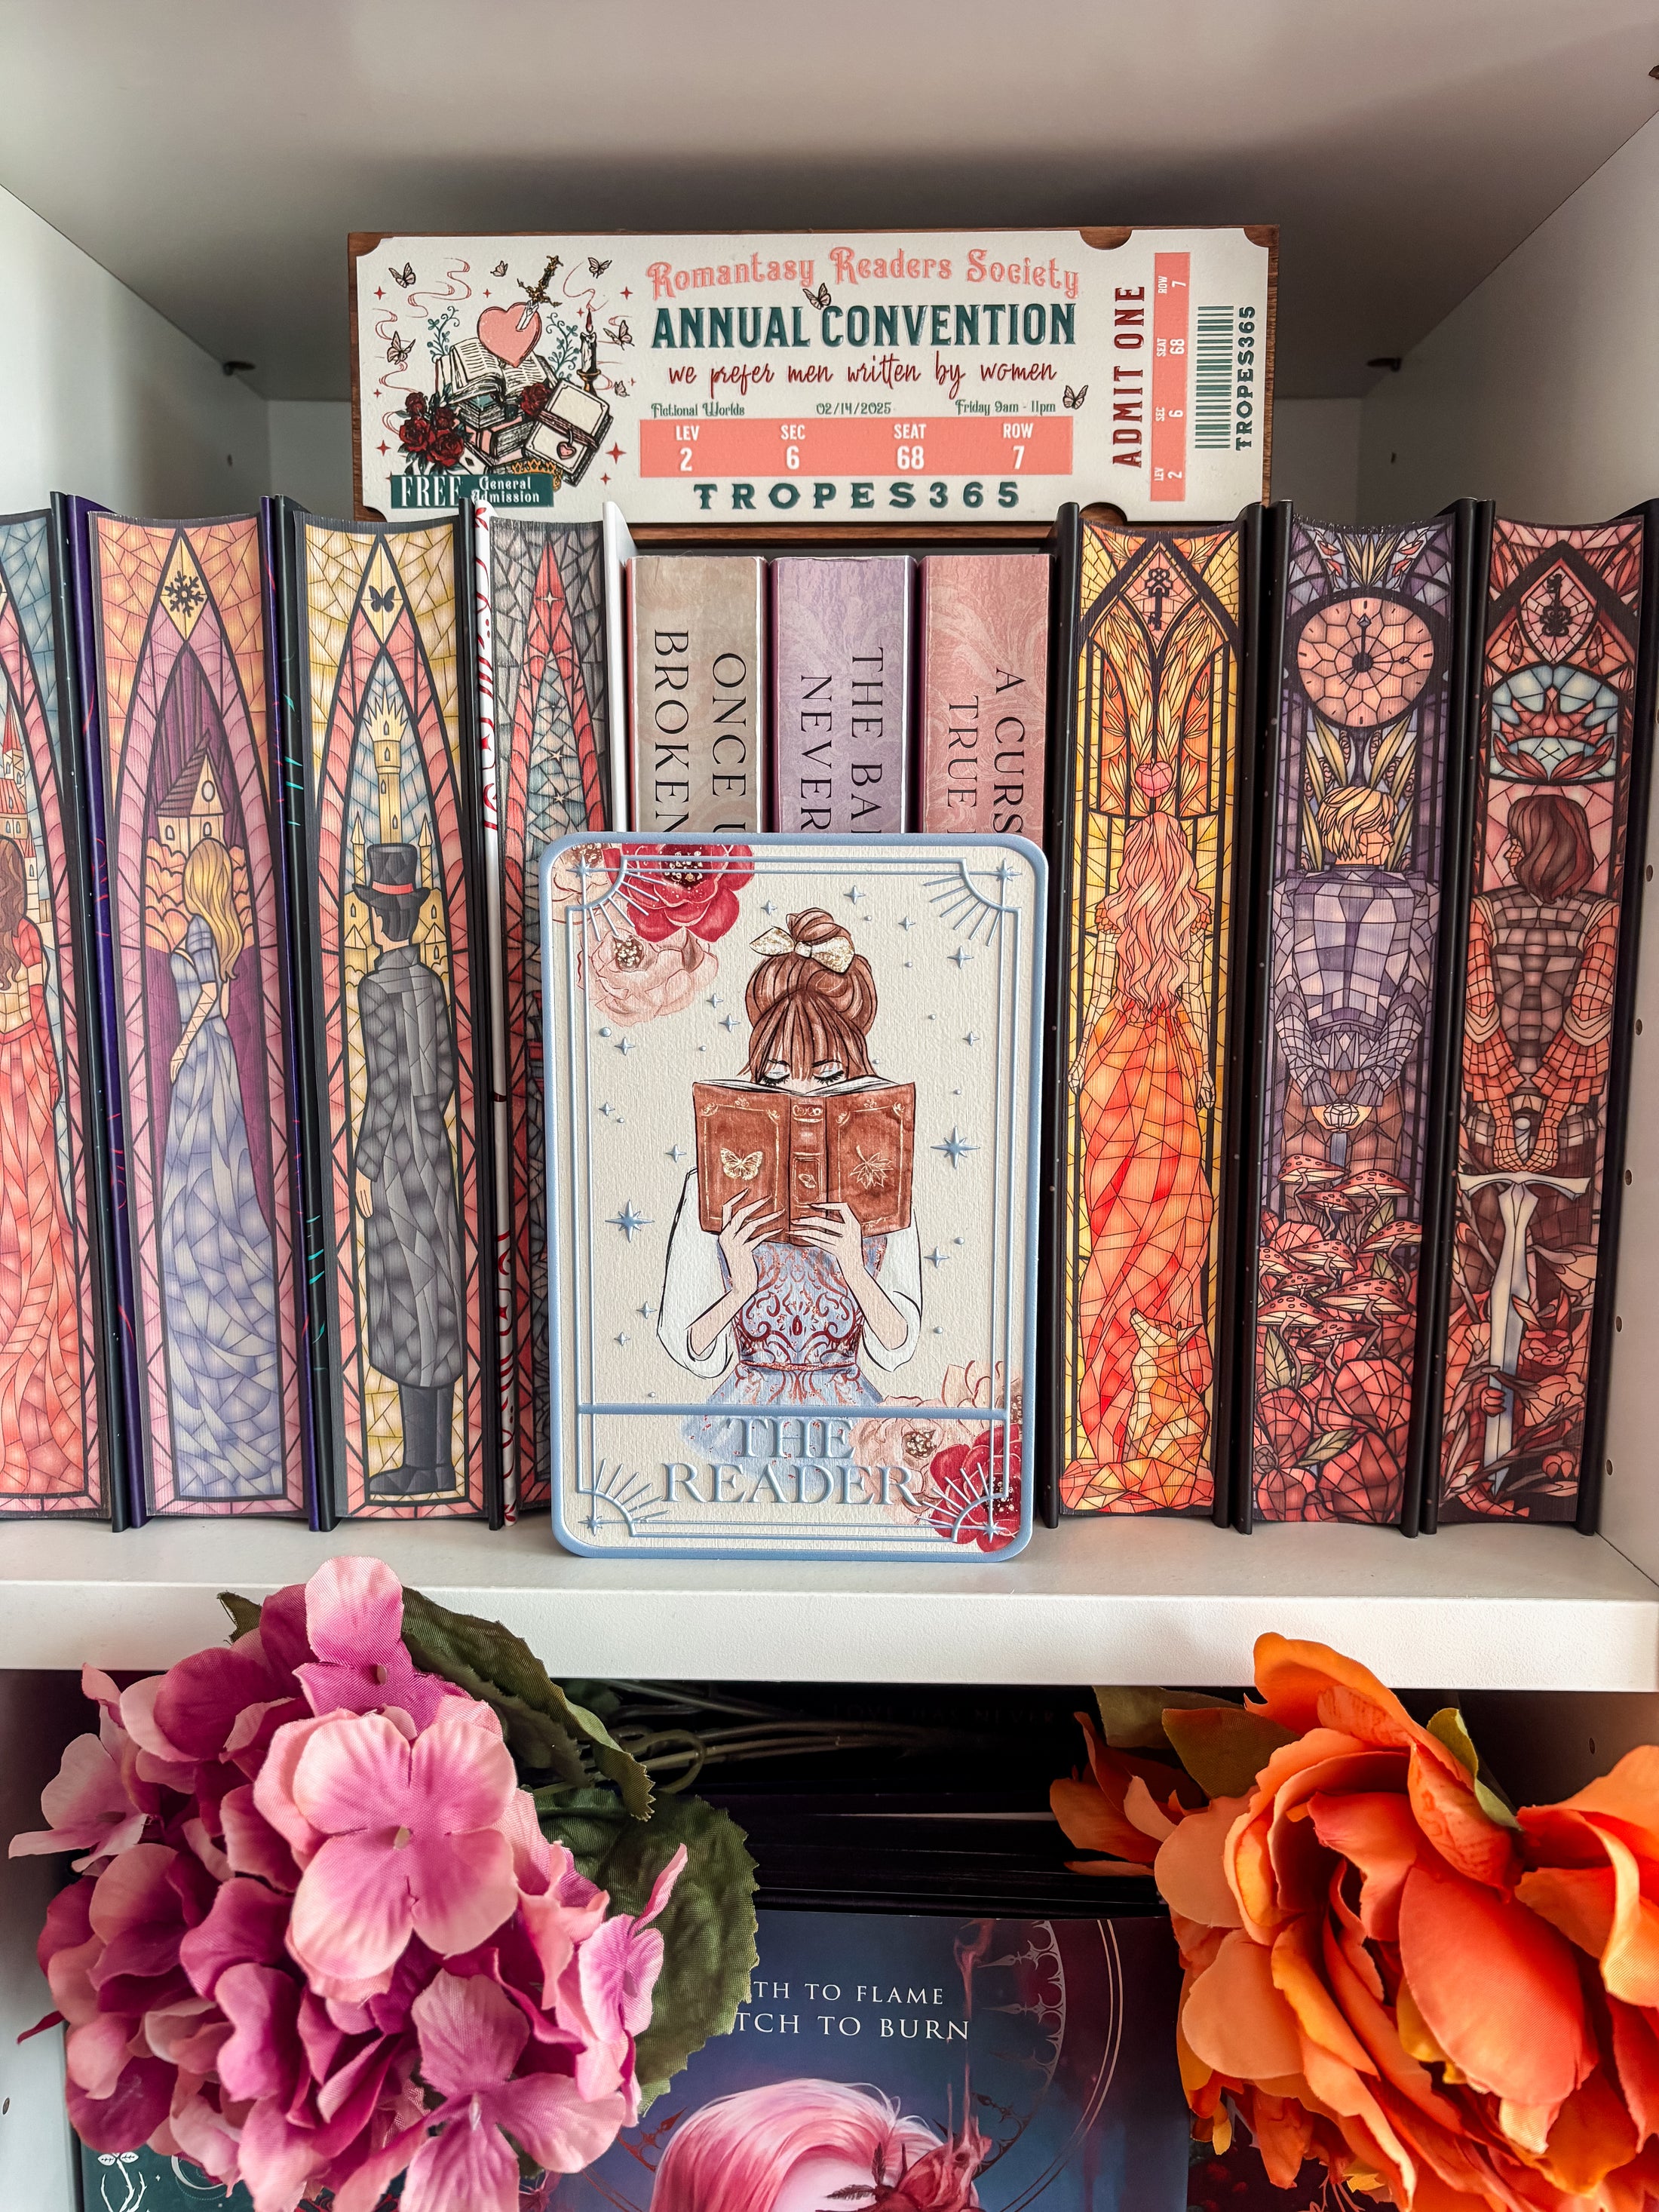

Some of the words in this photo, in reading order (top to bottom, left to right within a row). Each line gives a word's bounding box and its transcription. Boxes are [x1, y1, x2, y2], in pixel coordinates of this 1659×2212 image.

[646, 252, 815, 301] Romantasy
[828, 246, 952, 286] Readers
[965, 248, 1079, 299] Society
[1157, 275, 1168, 294] ROW
[1171, 280, 1186, 288] 7
[651, 306, 811, 348] ANNUAL
[821, 303, 1077, 348] CONVENTION
[1113, 286, 1145, 350] ONE
[1156, 337, 1167, 357] SEAT
[1169, 338, 1185, 355] 68
[668, 366, 698, 385] we
[710, 362, 775, 400] prefer
[787, 364, 834, 384] men
[847, 352, 922, 390] written
[935, 350, 967, 400] by
[980, 362, 1058, 382] women
[1235, 305, 1256, 451] TROPES365
[651, 403, 698, 419] Fictional
[701, 400, 745, 417] Worlds
[816, 401, 892, 415] 02/14/2025
[955, 398, 991, 416] Friday
[994, 400, 1019, 413] 9am
[1112, 365, 1143, 468] ADMIT
[1155, 407, 1165, 422] SEC
[1168, 410, 1184, 418] 6
[676, 425, 700, 441] LEV
[780, 425, 805, 440] SEC
[894, 423, 927, 439] SEAT
[1003, 423, 1034, 439] ROW
[680, 447, 693, 471] 2
[787, 445, 800, 470] 6
[897, 446, 925, 470] 68
[1013, 445, 1025, 470] 7
[478, 476, 531, 491] General
[1153, 467, 1164, 481] LEV
[1167, 471, 1182, 479] 2
[400, 476, 462, 507] FREE
[471, 489, 540, 503] Admission
[693, 480, 1020, 510] TROPES365
[851, 646, 884, 738] THE
[995, 667, 1026, 695] A
[655, 629, 689, 833] BROKEN
[712, 652, 747, 797] ONCE
[800, 675, 833, 831] NEVER
[947, 695, 979, 808] TRUE
[851, 762, 883, 833] BA
[727, 1418, 857, 1460] THE
[661, 1461, 926, 1507] READER
[804, 1983, 841, 2001] TO
[857, 1985, 943, 2005] FLAME
[817, 2015, 861, 2036] TO
[879, 2017, 969, 2040] BURN
